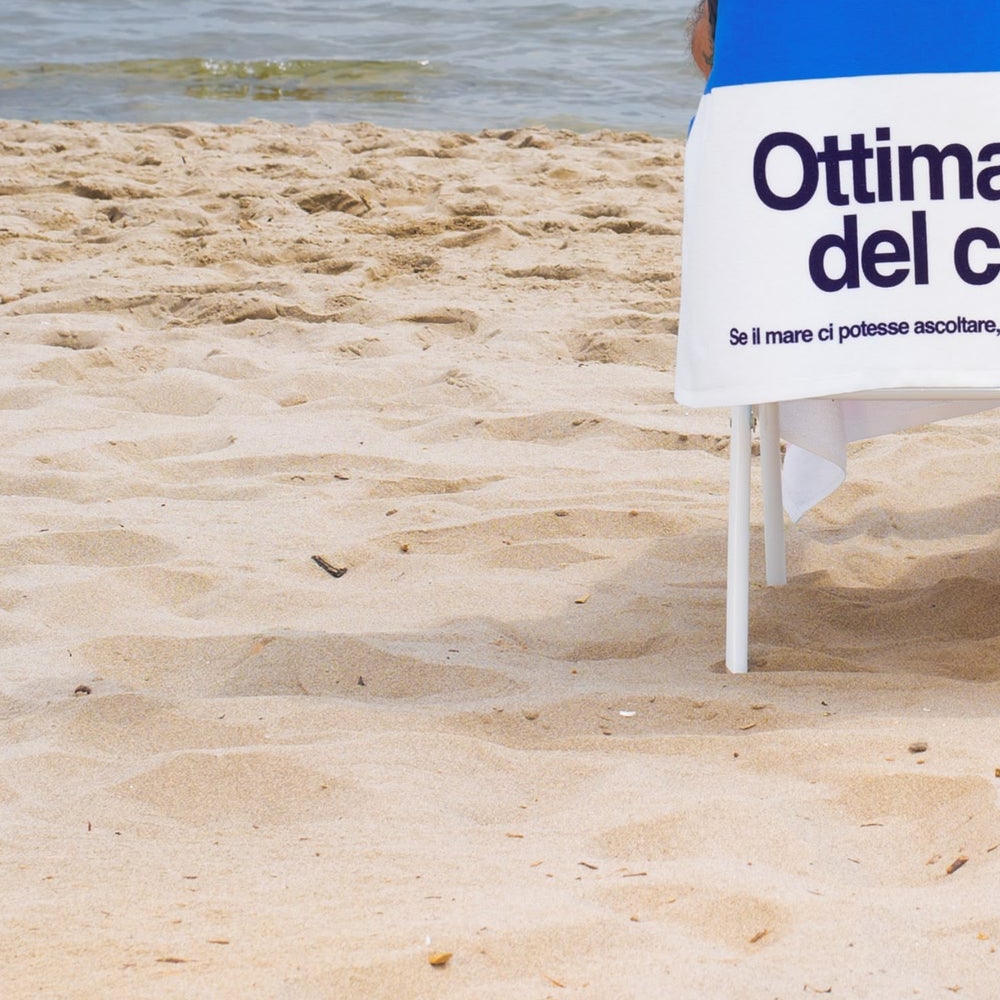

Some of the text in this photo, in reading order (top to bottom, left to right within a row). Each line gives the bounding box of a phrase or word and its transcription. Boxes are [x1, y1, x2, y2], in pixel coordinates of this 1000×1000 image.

[808, 210, 930, 293] del
[729, 327, 749, 346] Se
[752, 327, 761, 345] il
[765, 328, 814, 345] mare
[817, 322, 834, 342] ci
[838, 320, 910, 344] potesse
[913, 315, 1000, 337] ascoltare,
